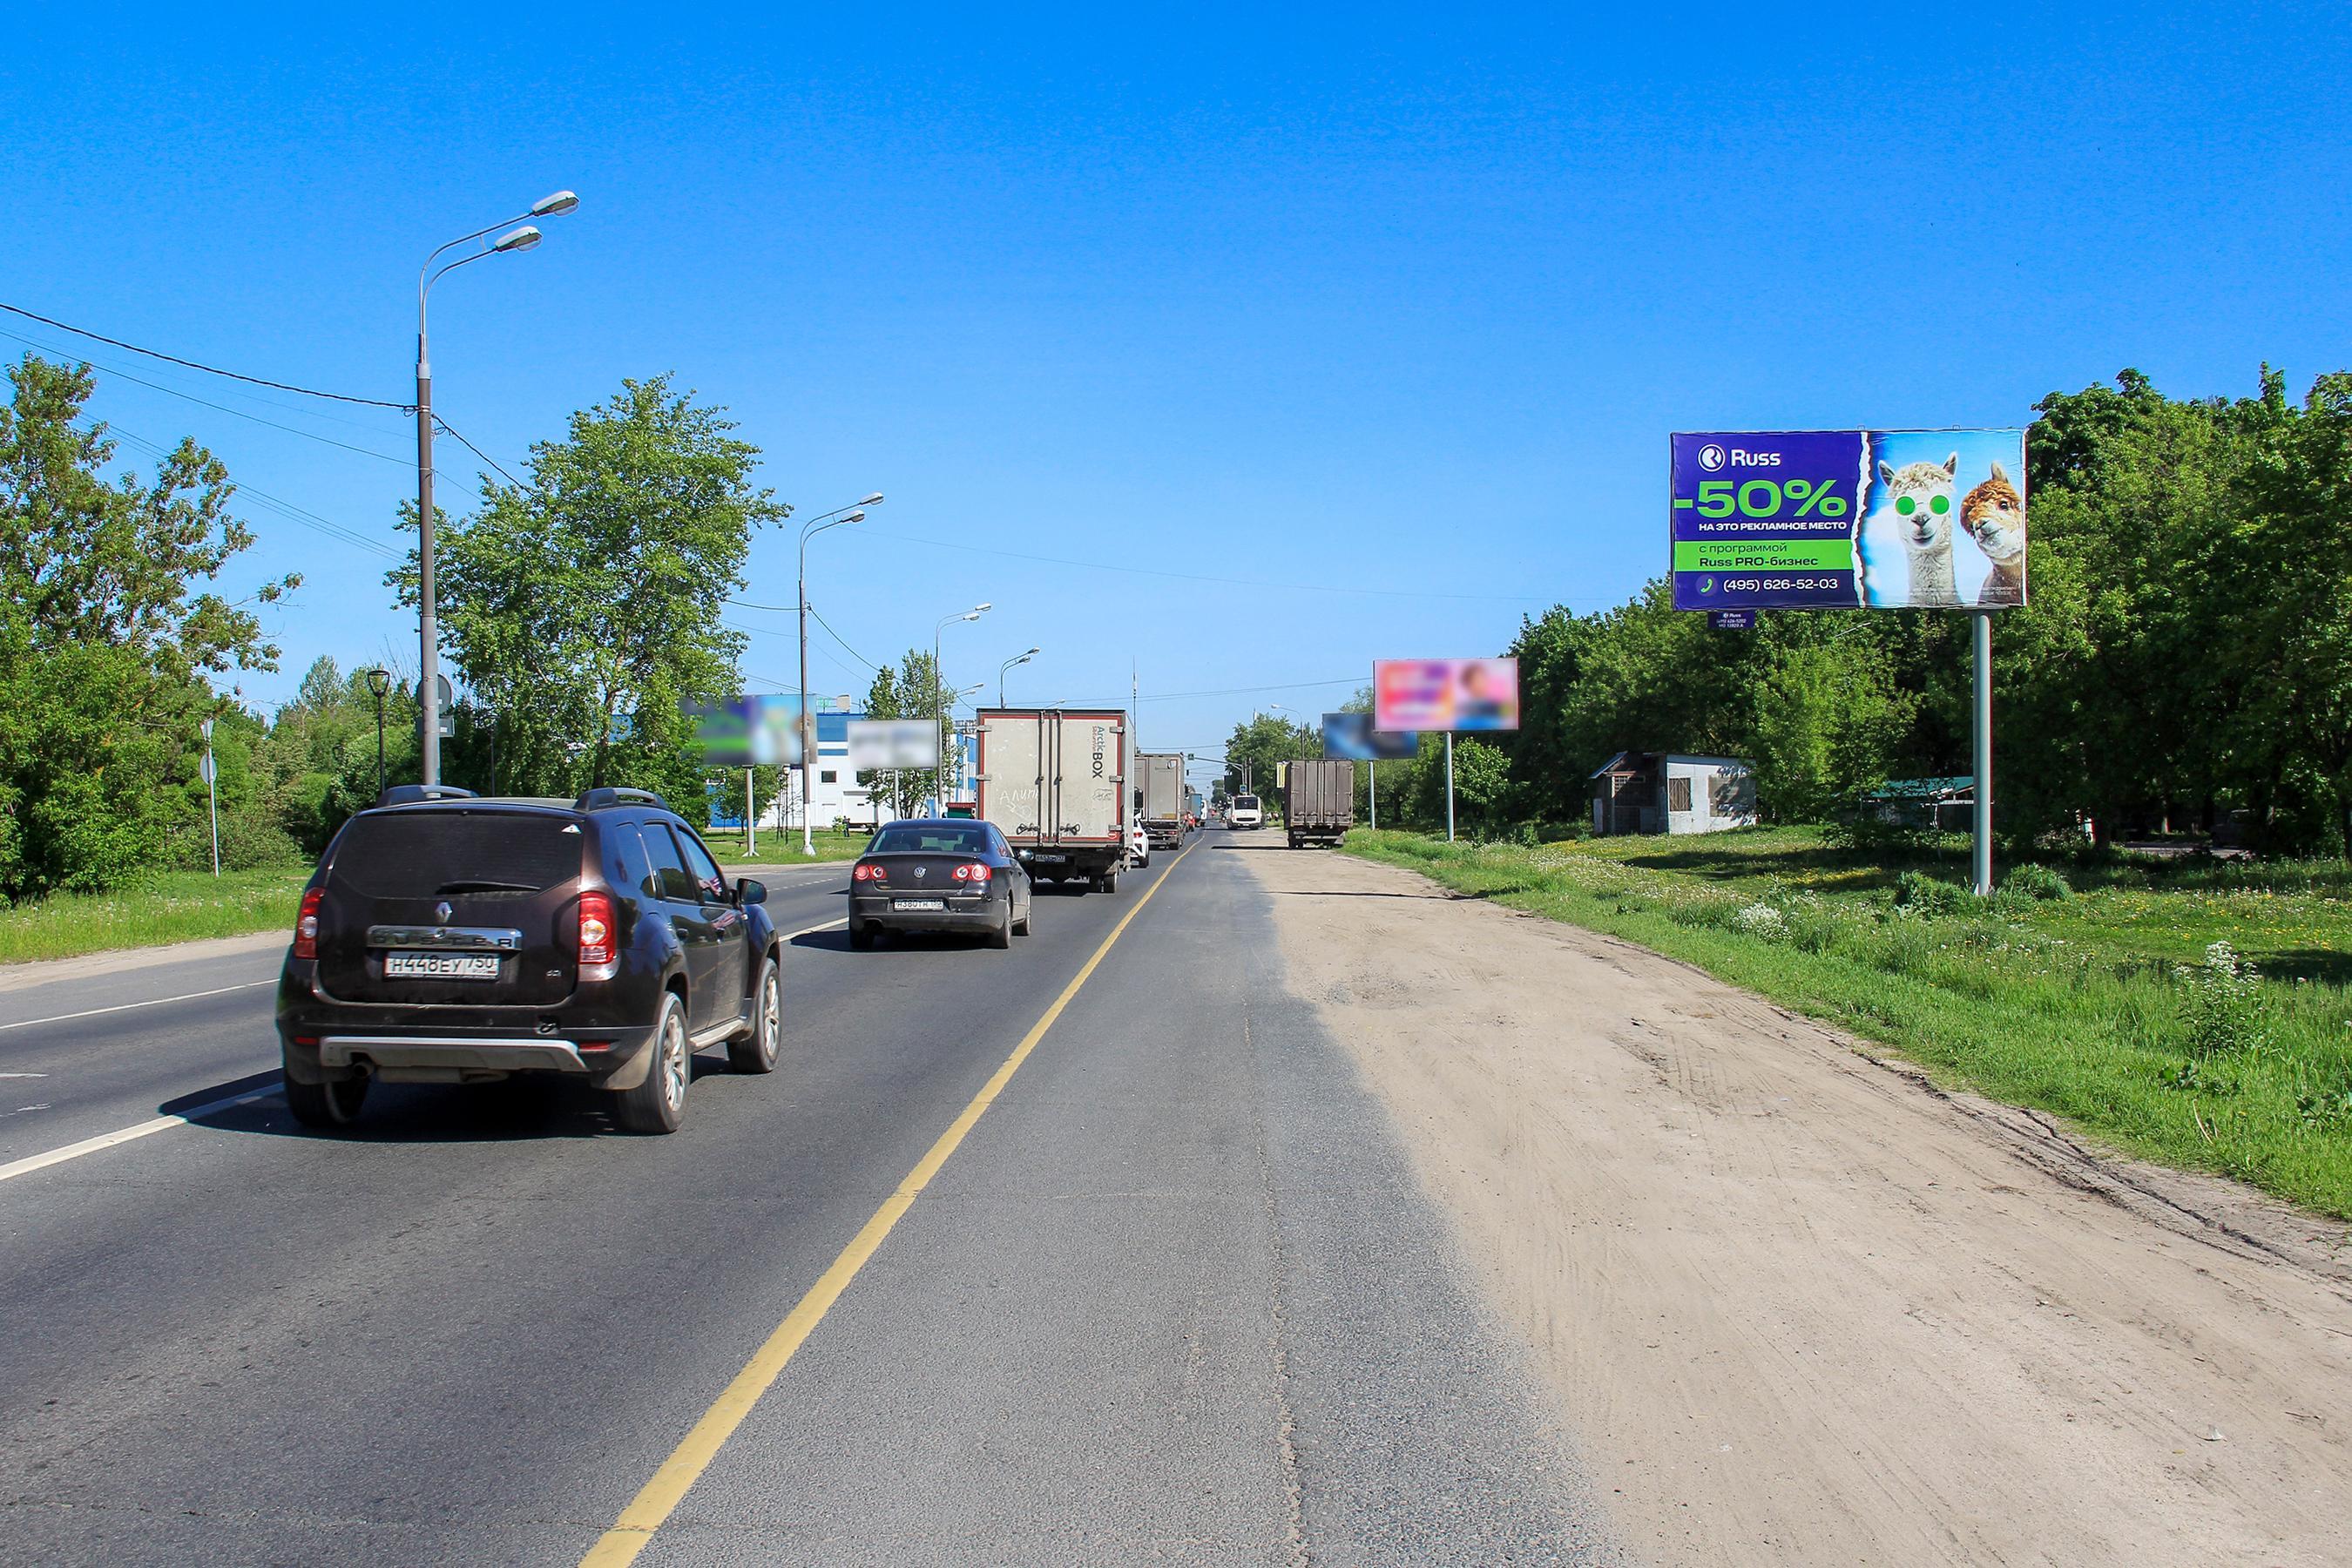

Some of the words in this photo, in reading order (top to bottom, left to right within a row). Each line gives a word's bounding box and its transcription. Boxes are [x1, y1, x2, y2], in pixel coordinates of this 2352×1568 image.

[1731, 449, 1781, 467] Russ
[1673, 479, 1848, 518] -50%
[1716, 523, 1738, 531] ЭТО
[1808, 522, 1848, 531] МЕСТО
[1709, 542, 1788, 555] программой
[1700, 558, 1733, 567] Russ
[1735, 557, 1819, 566] PRO-бизнес
[1723, 578, 1761, 592] (495)
[1762, 578, 1838, 590] 626-52-03
[373, 935, 512, 948] DUSTER
[468, 954, 495, 968] 750
